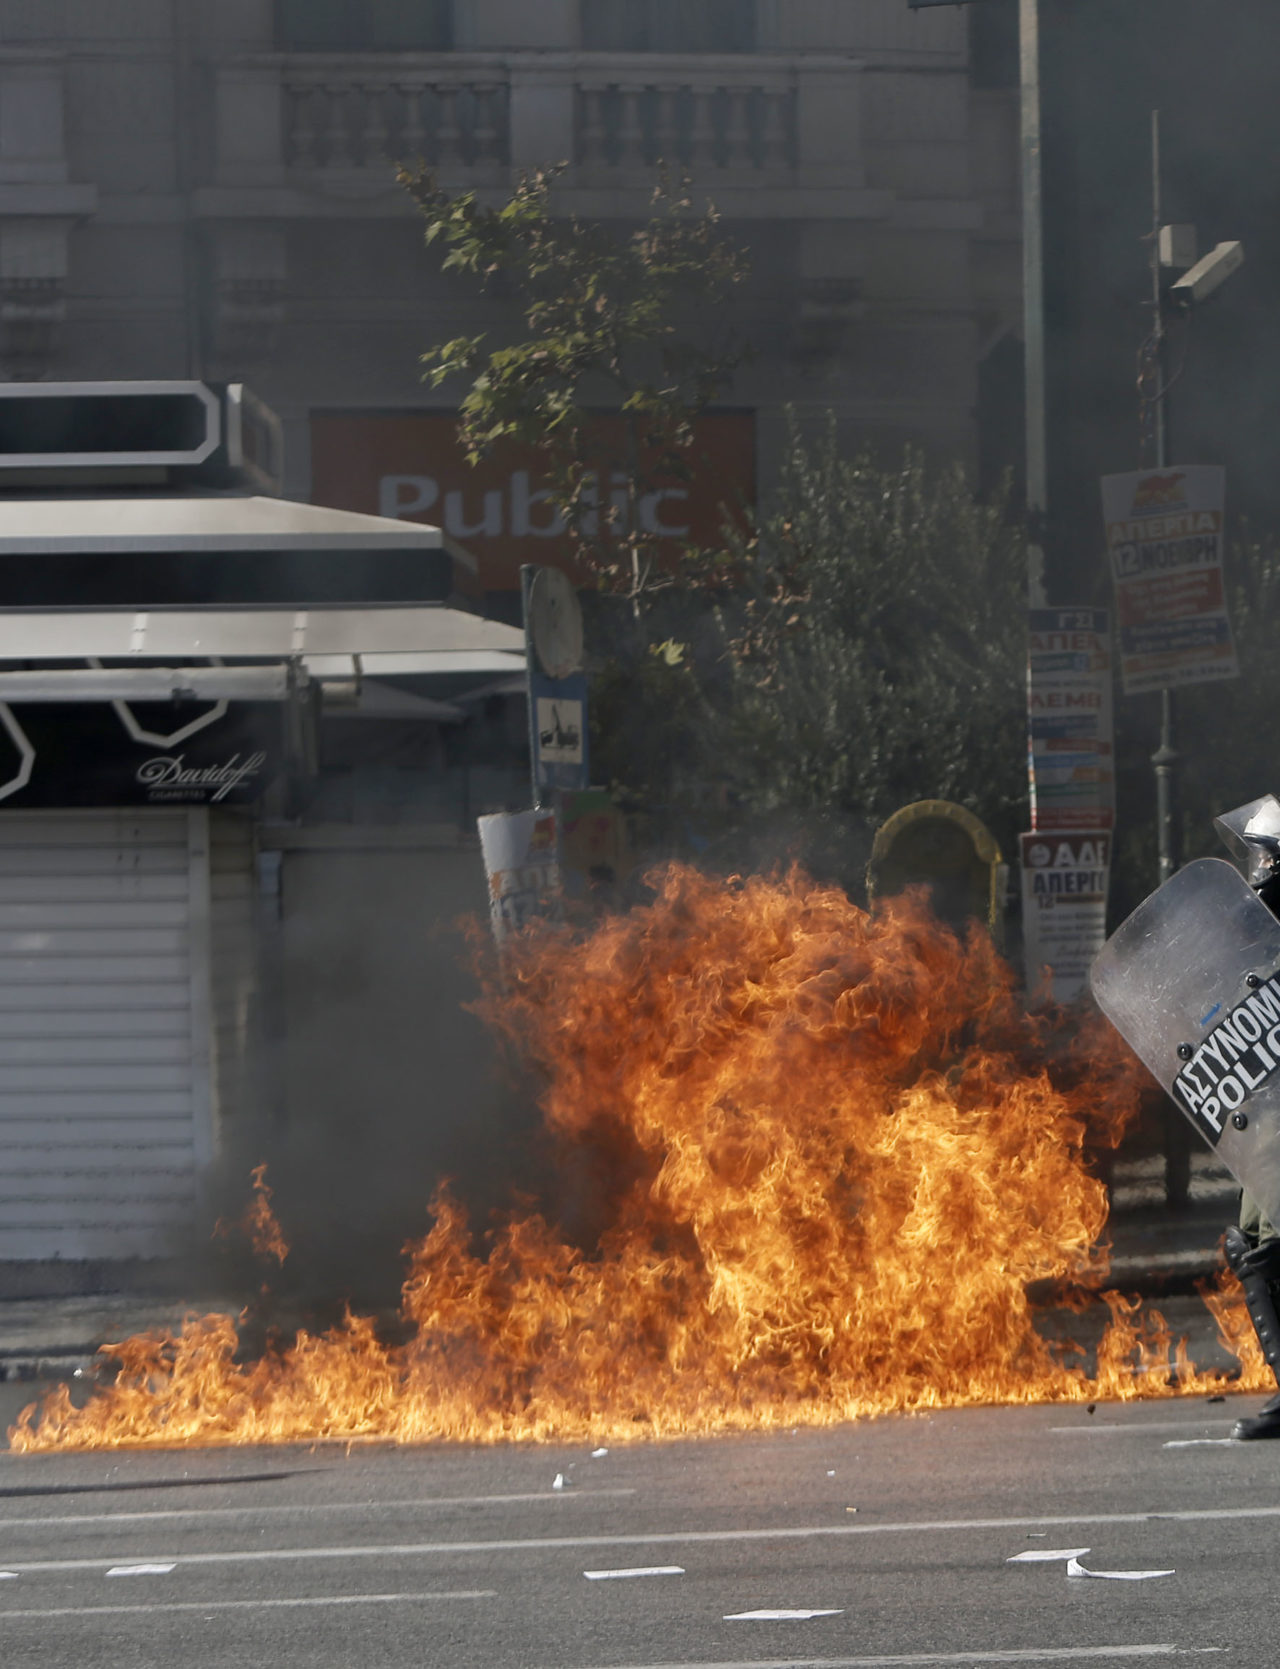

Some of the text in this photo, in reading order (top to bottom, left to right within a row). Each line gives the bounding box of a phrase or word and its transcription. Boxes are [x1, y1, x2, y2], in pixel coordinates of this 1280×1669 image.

[379, 469, 690, 540] Public
[1110, 512, 1218, 545] ΑΠΕΡΓΙΑ
[1115, 540, 1139, 574] 12
[136, 750, 268, 803] Davidoff
